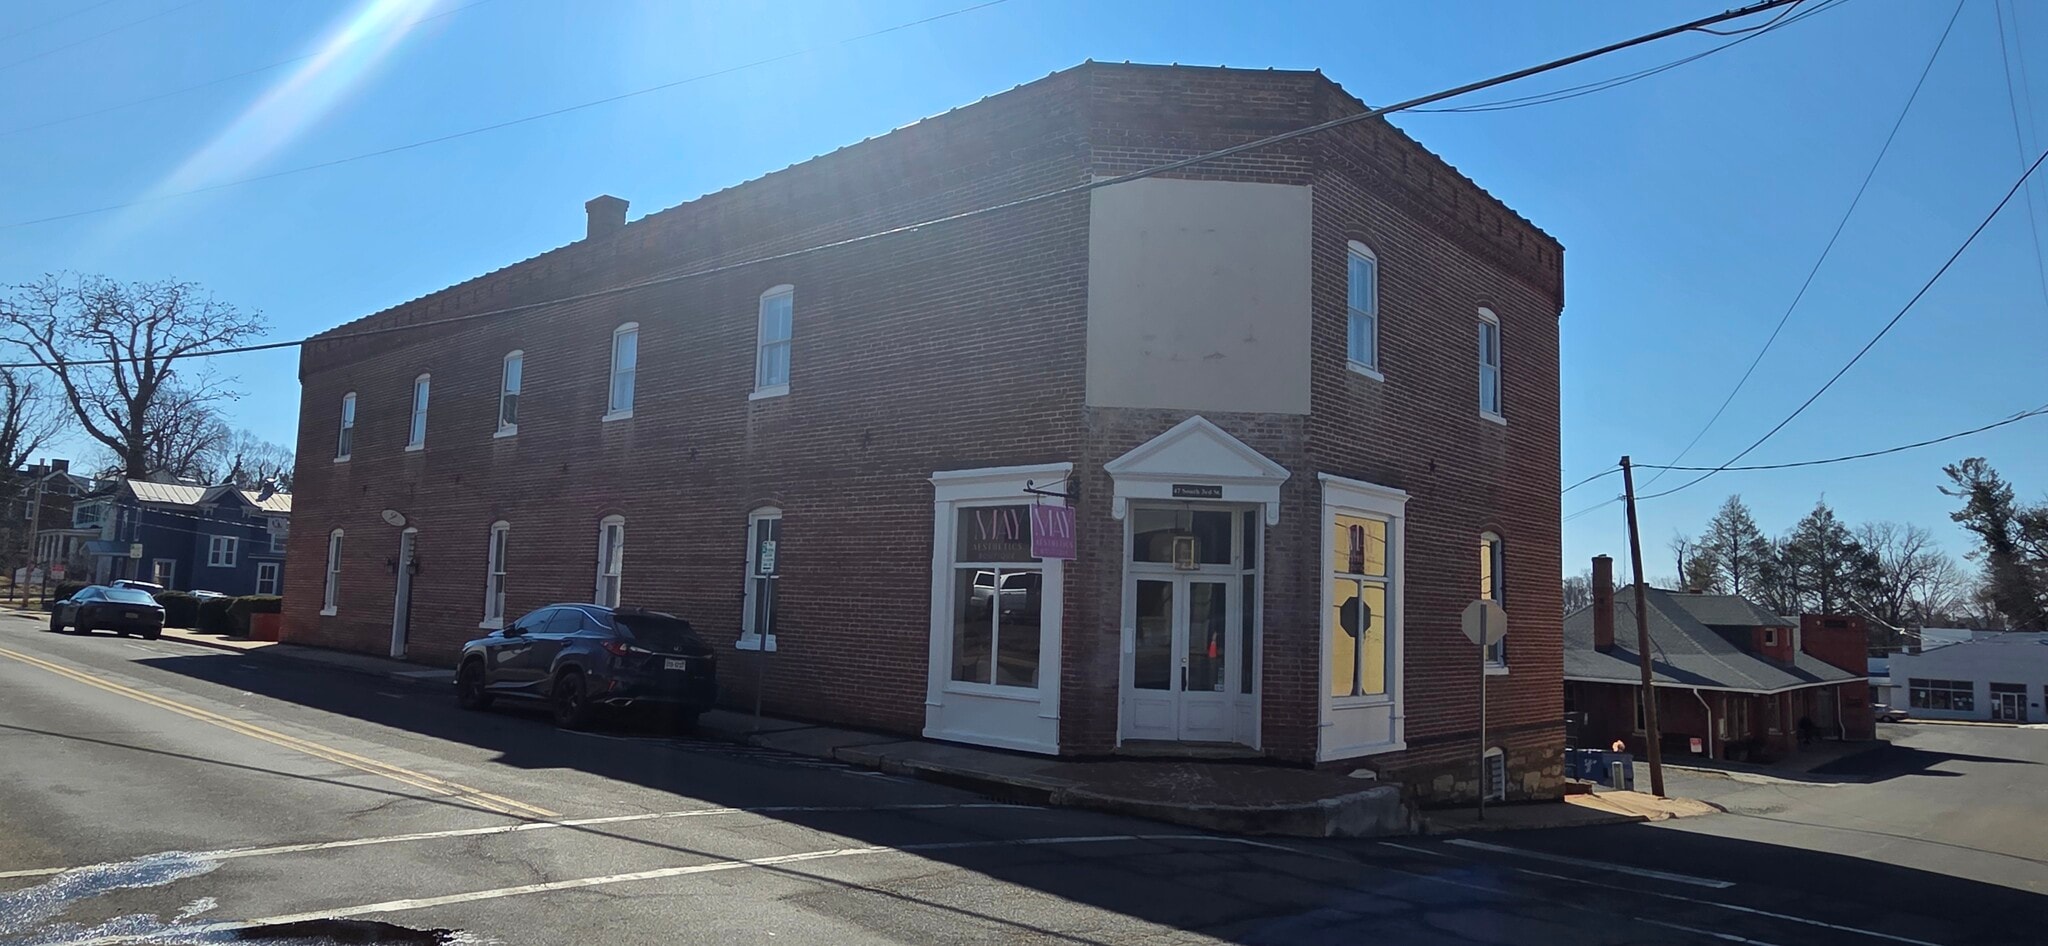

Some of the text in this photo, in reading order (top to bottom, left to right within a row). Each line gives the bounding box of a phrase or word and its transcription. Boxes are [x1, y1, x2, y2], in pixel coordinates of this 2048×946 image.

[974, 508, 1025, 540] MAY
[1035, 508, 1073, 538] MAY
[973, 543, 1023, 552] AESTHETICS
